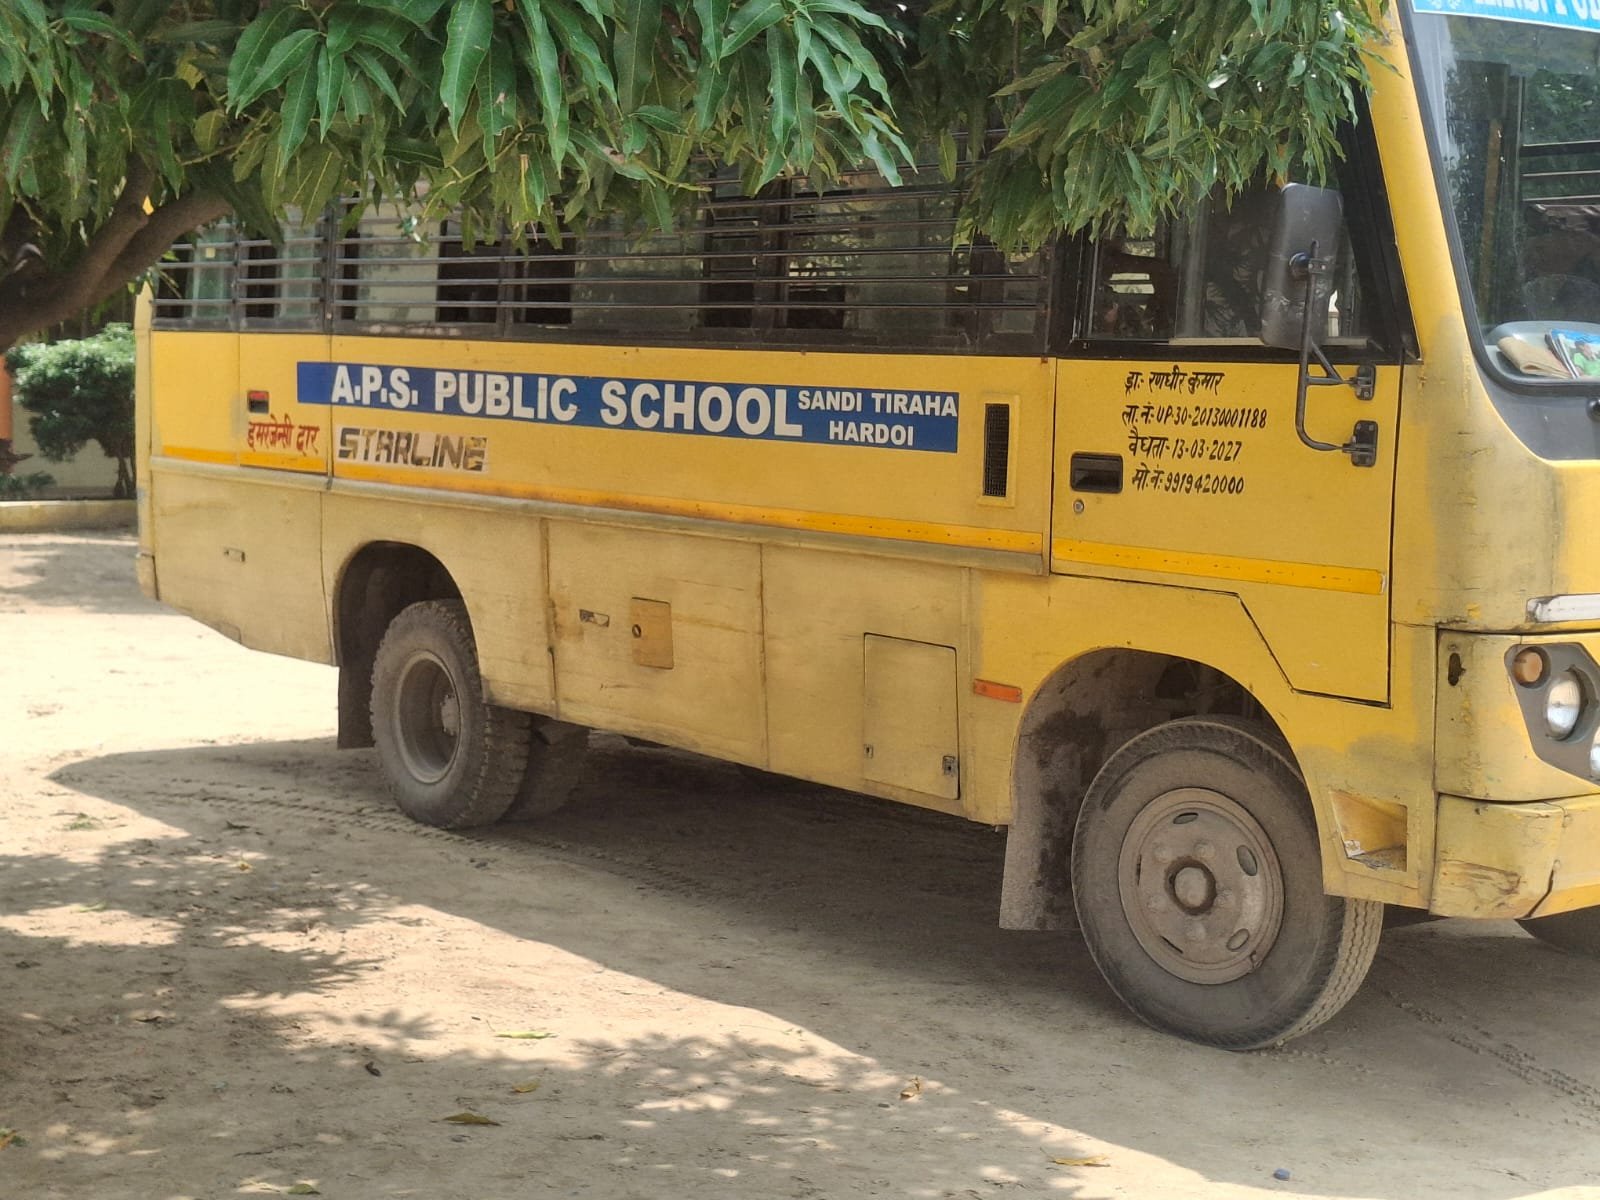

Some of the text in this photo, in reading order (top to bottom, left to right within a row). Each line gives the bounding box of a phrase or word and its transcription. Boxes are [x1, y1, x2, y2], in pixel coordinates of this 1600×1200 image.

[1187, 371, 1226, 396] कुमार
[331, 365, 803, 437] A.P.S. PUBLIC SCHOOL
[797, 390, 958, 417] SANDI TIRAHA
[828, 420, 914, 446] HARDOI
[338, 427, 488, 472] STARLINE
